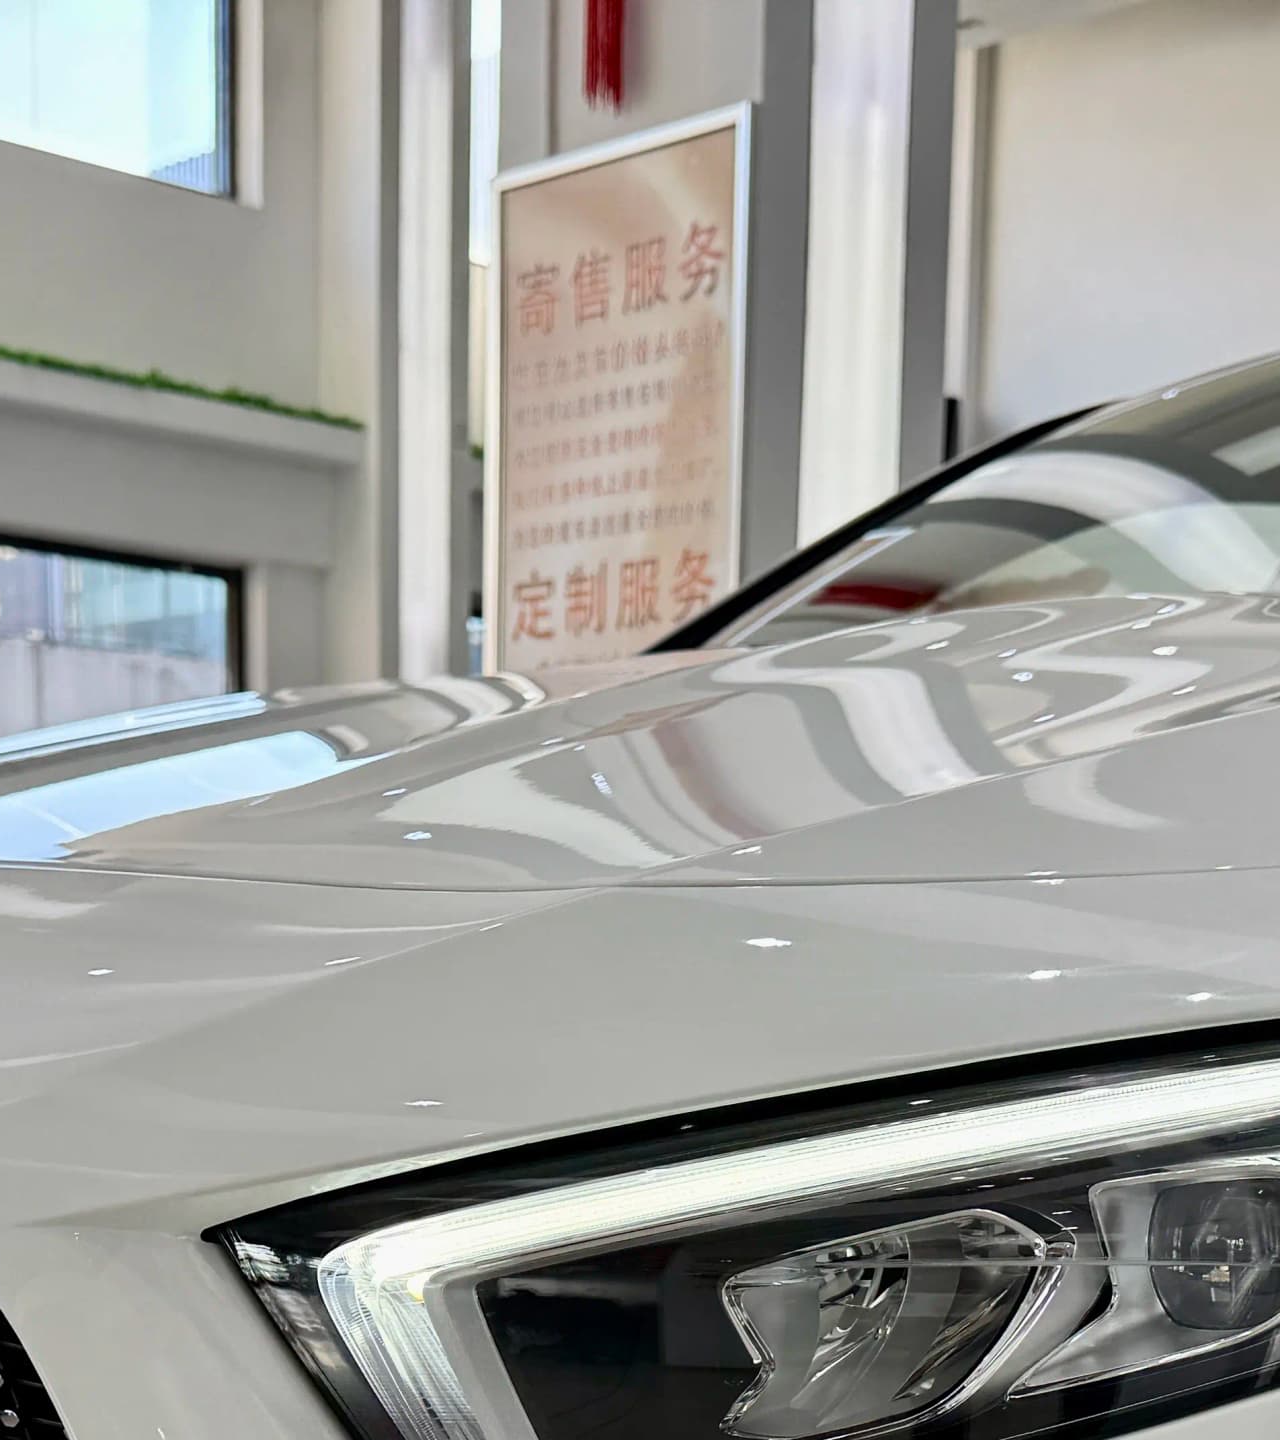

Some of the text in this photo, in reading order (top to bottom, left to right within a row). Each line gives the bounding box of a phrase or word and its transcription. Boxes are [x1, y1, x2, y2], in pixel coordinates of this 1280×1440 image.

[516, 219, 727, 337] 寄售服务
[511, 548, 716, 644] 定制服务
